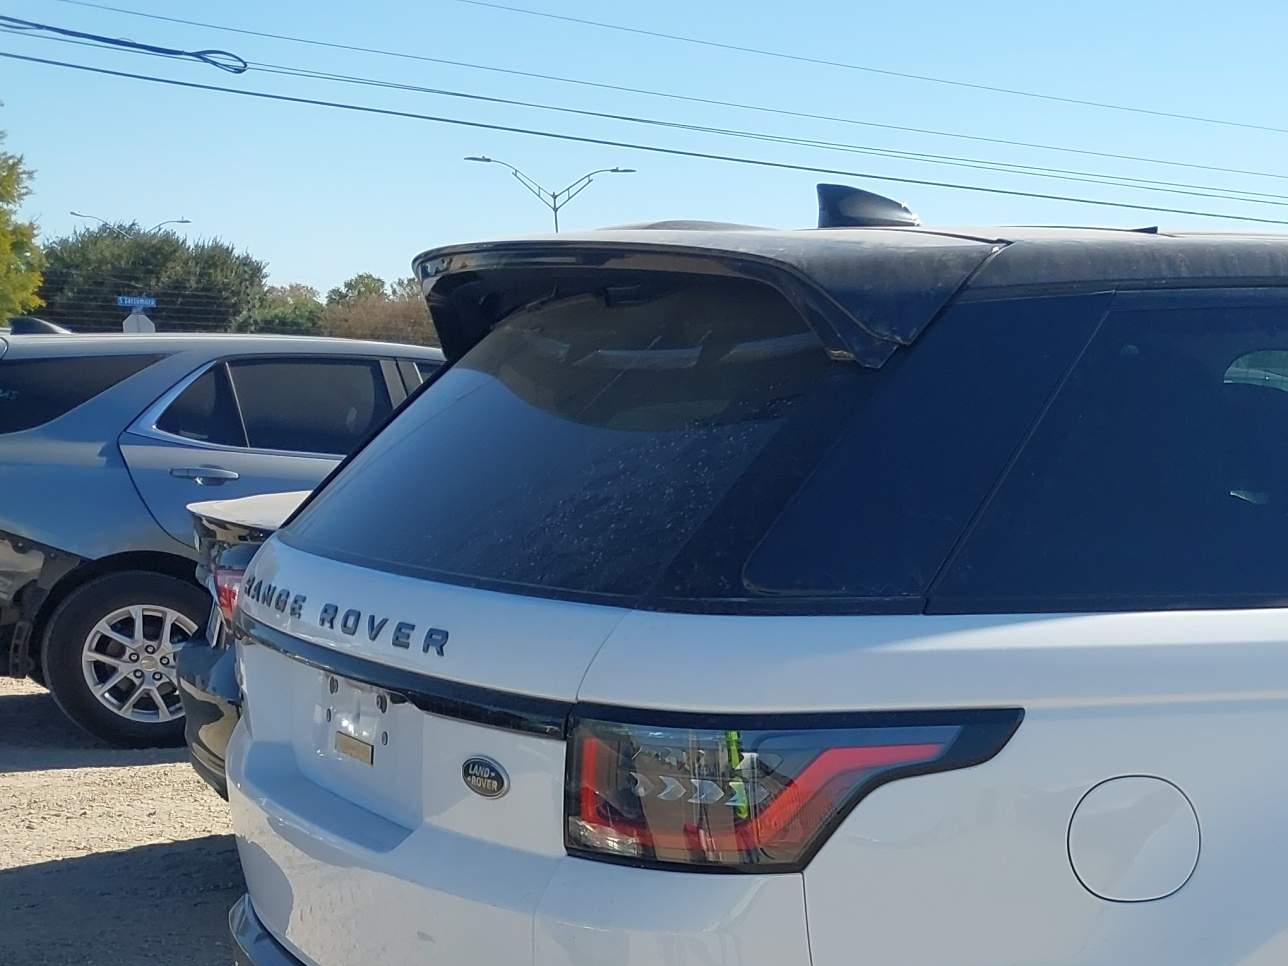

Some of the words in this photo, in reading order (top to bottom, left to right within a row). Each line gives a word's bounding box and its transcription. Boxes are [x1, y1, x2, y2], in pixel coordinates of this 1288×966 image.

[244, 576, 307, 620] RANGE
[319, 603, 449, 656] ROVER
[469, 763, 490, 778] LAND
[471, 776, 498, 792] ROVER
